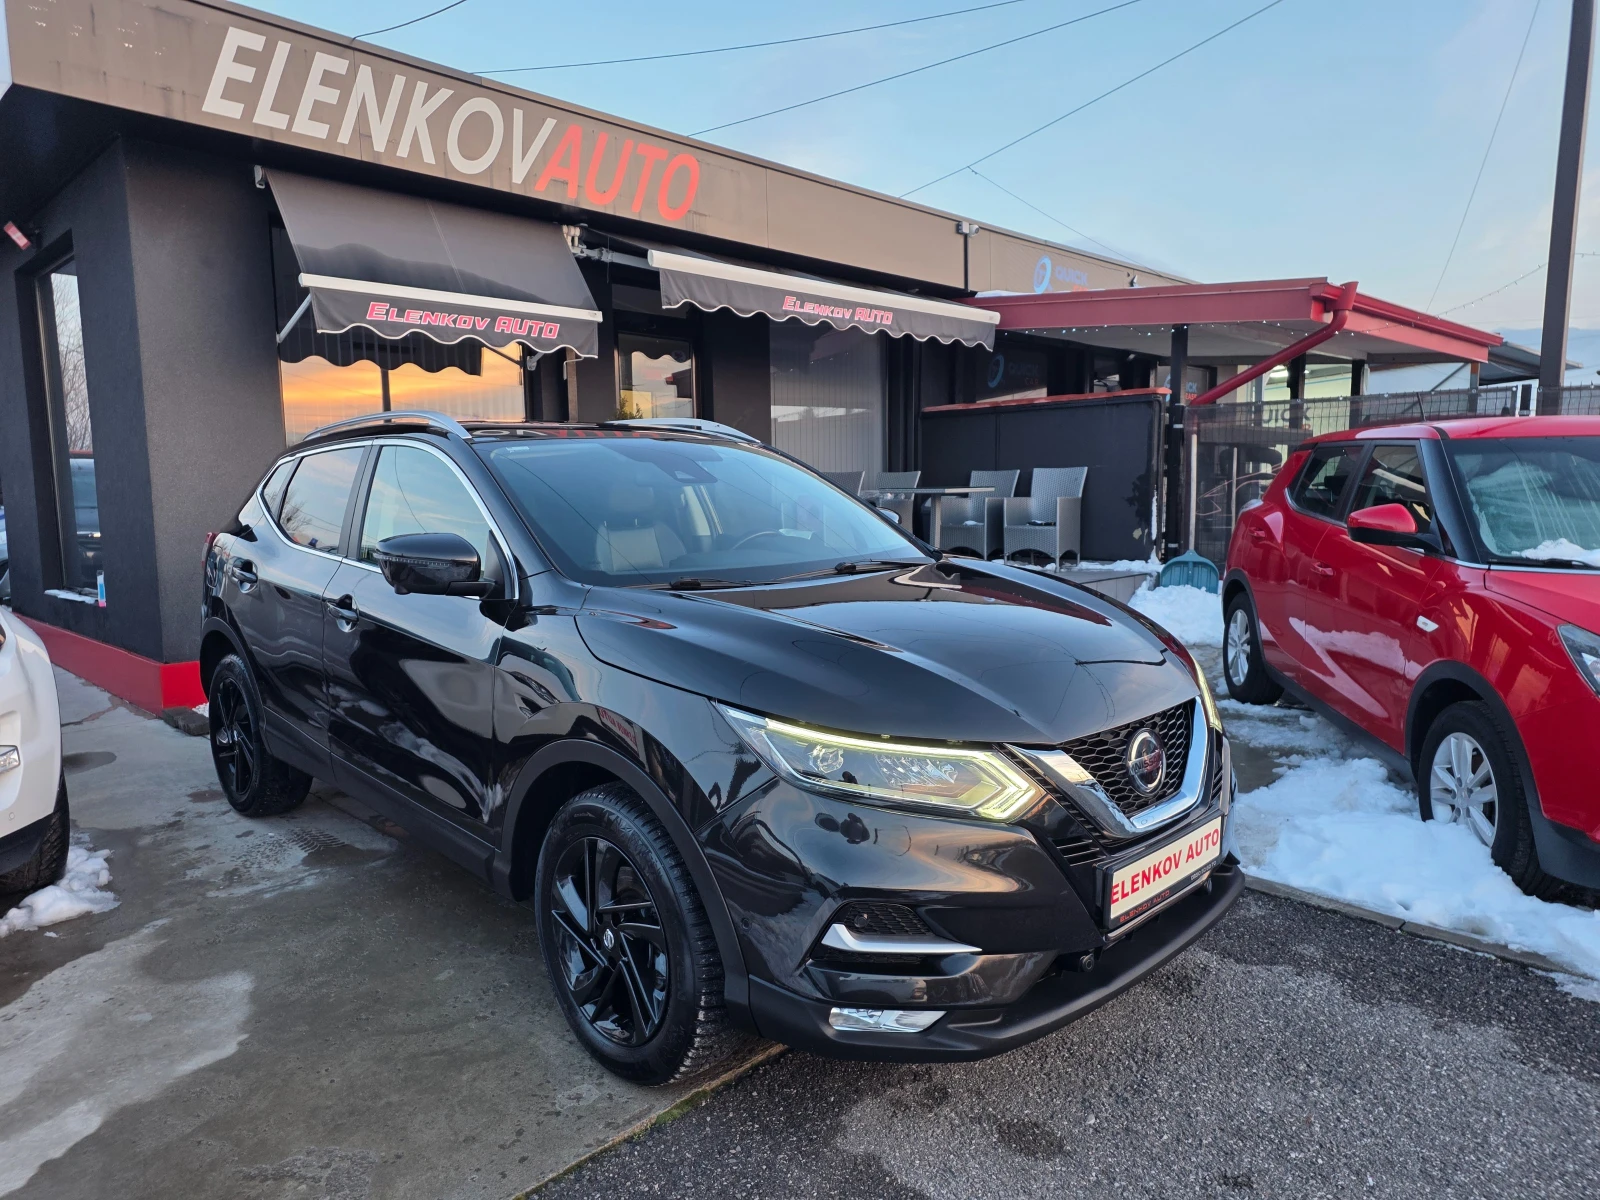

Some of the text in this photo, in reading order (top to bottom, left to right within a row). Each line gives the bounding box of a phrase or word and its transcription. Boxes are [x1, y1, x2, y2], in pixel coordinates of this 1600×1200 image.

[366, 301, 560, 339] ELENKOV AUTO
[782, 295, 893, 324] ELENKOV AUTO
[1111, 849, 1182, 905] ELENKOV
[1185, 828, 1220, 863] AUTO
